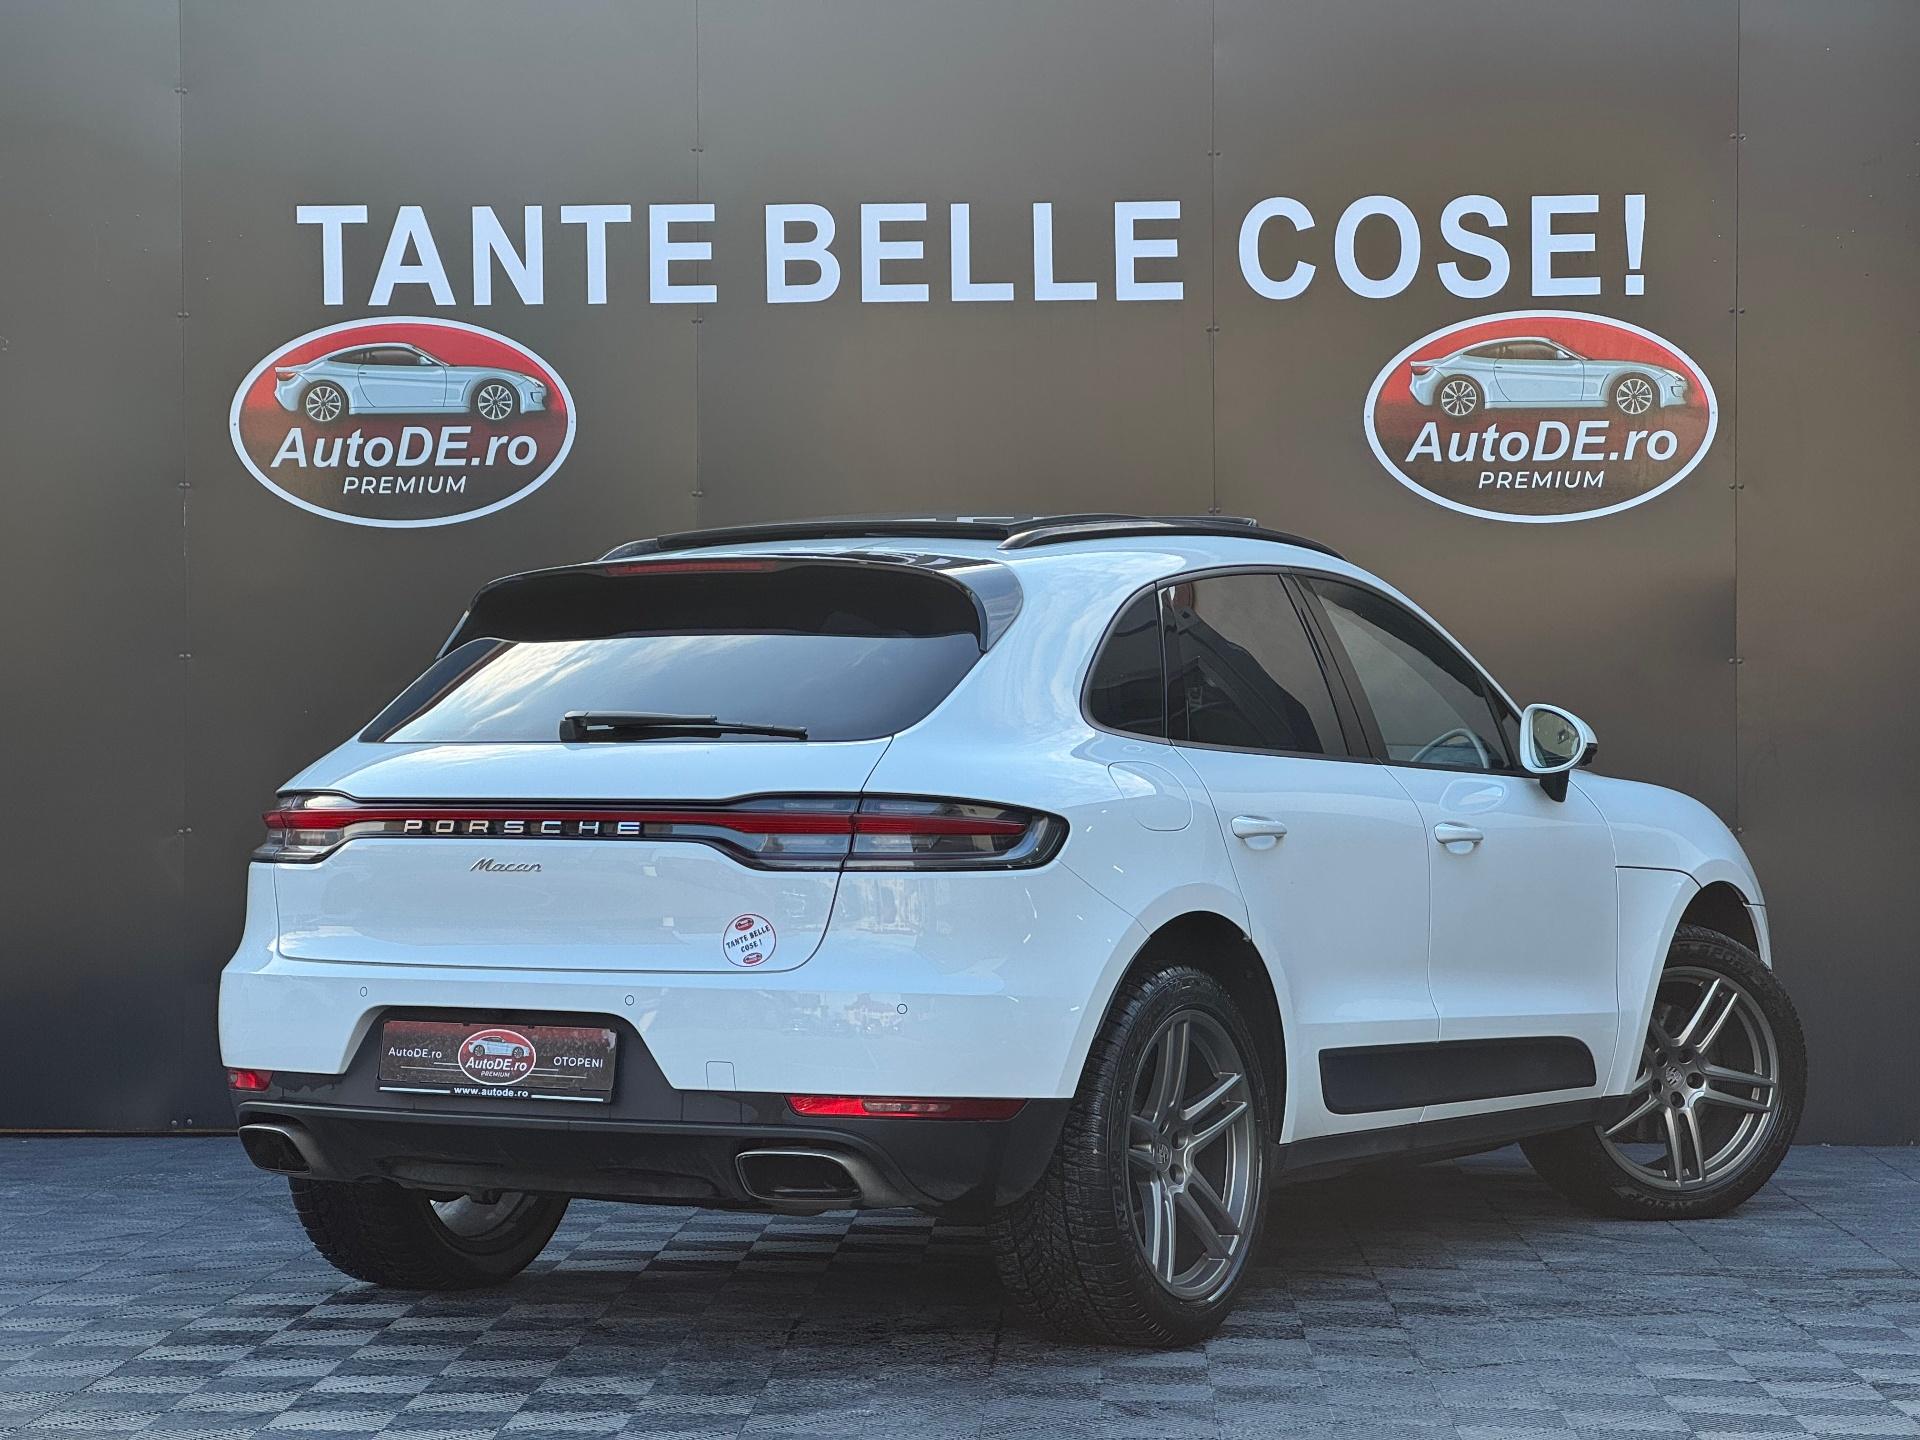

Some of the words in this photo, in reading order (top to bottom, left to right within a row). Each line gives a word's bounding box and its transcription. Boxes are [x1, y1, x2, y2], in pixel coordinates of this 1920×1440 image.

[296, 203, 718, 306] TANTE
[765, 201, 1185, 304] BELLE
[1238, 194, 1646, 300] COSE!
[270, 425, 538, 468] AutoDE.ro
[1405, 420, 1678, 462] AutoDE.ro
[342, 475, 467, 494] PREMIUM
[1478, 470, 1605, 489] PREMIUM
[403, 820, 641, 835] PORSCHE
[470, 857, 542, 872] Macan
[726, 934, 748, 949] TANTE
[749, 925, 771, 939] BELLE
[388, 1046, 442, 1059] AutoDE.ro
[465, 1056, 528, 1072] AutoDE.ro
[553, 1056, 603, 1069] OTOPENI
[480, 1070, 511, 1078] PREMIUM
[453, 1086, 529, 1098] www.autode.ro
